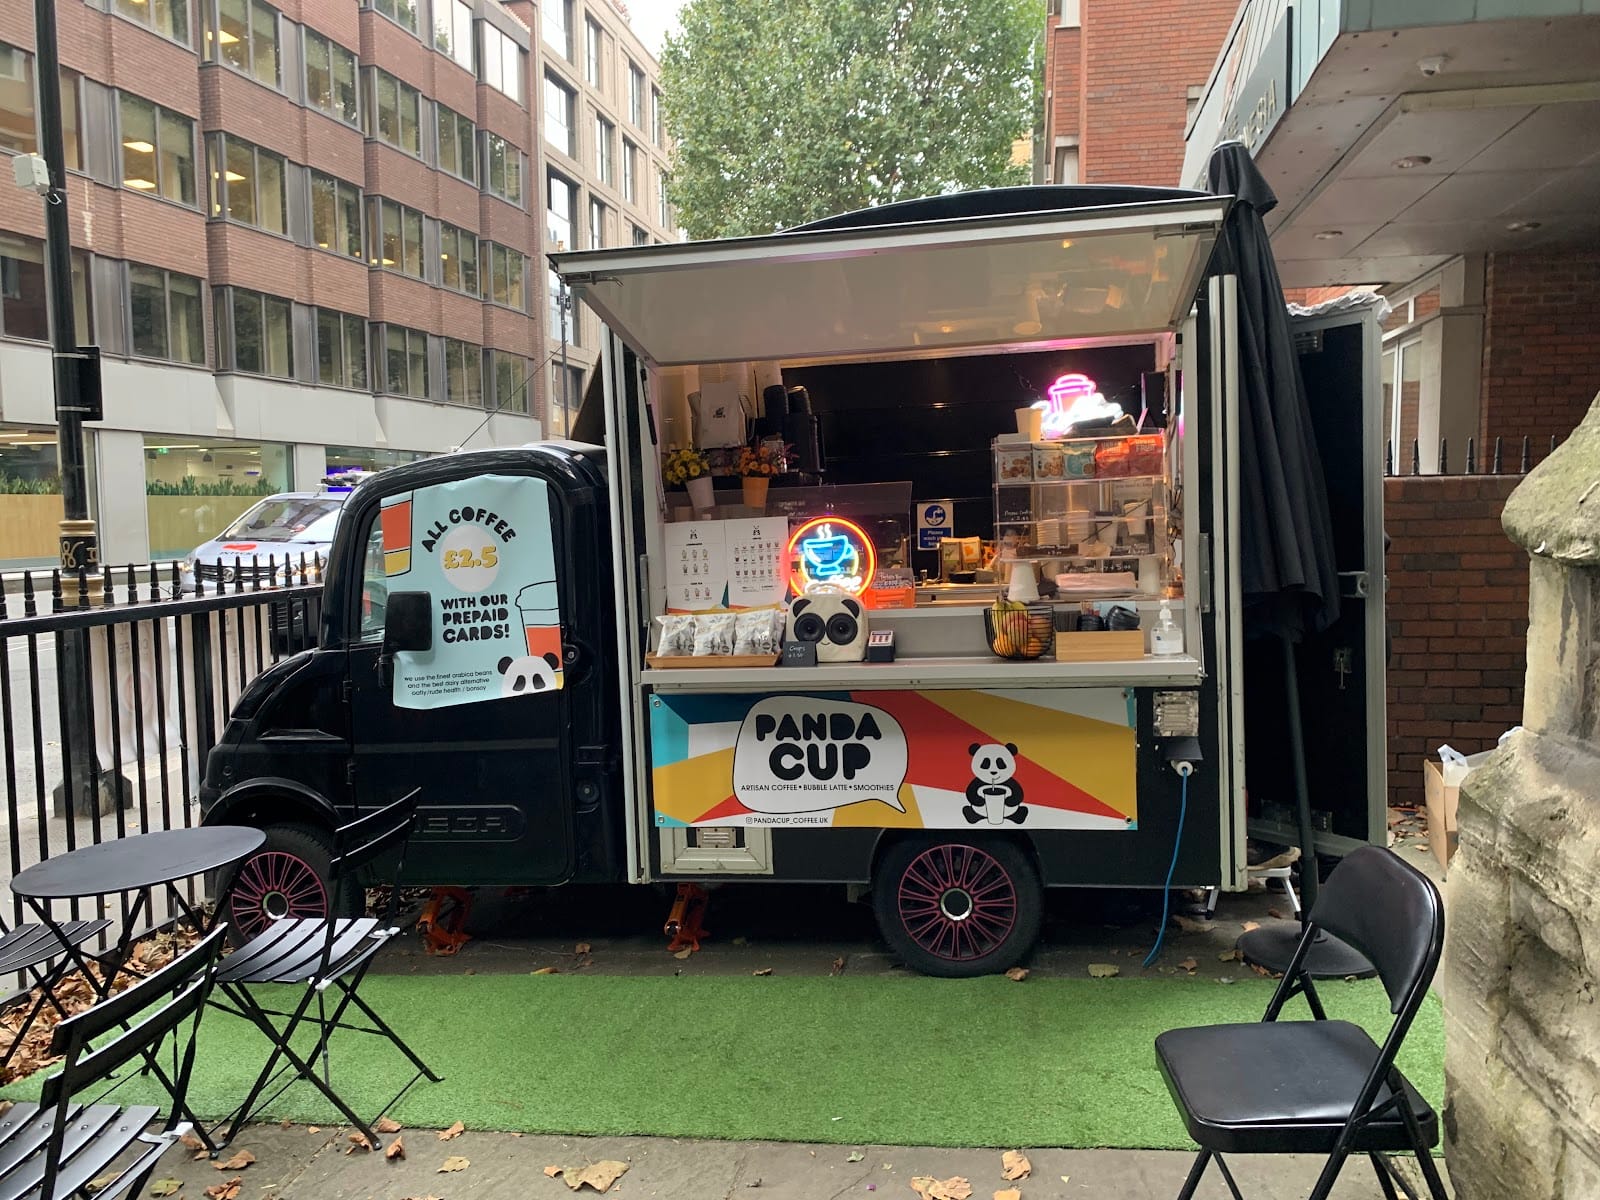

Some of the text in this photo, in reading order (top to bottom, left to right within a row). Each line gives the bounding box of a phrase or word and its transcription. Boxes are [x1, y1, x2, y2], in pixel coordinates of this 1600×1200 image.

[421, 506, 516, 553] ALL COFFEE
[444, 545, 498, 569] £2.5
[440, 593, 508, 610] WITH OUR
[442, 608, 509, 626] PREPAID
[442, 623, 510, 644] CARDS!
[436, 672, 451, 680] finest
[445, 679, 459, 687] dairy
[757, 713, 881, 741] PANDA
[769, 743, 870, 780] CUP
